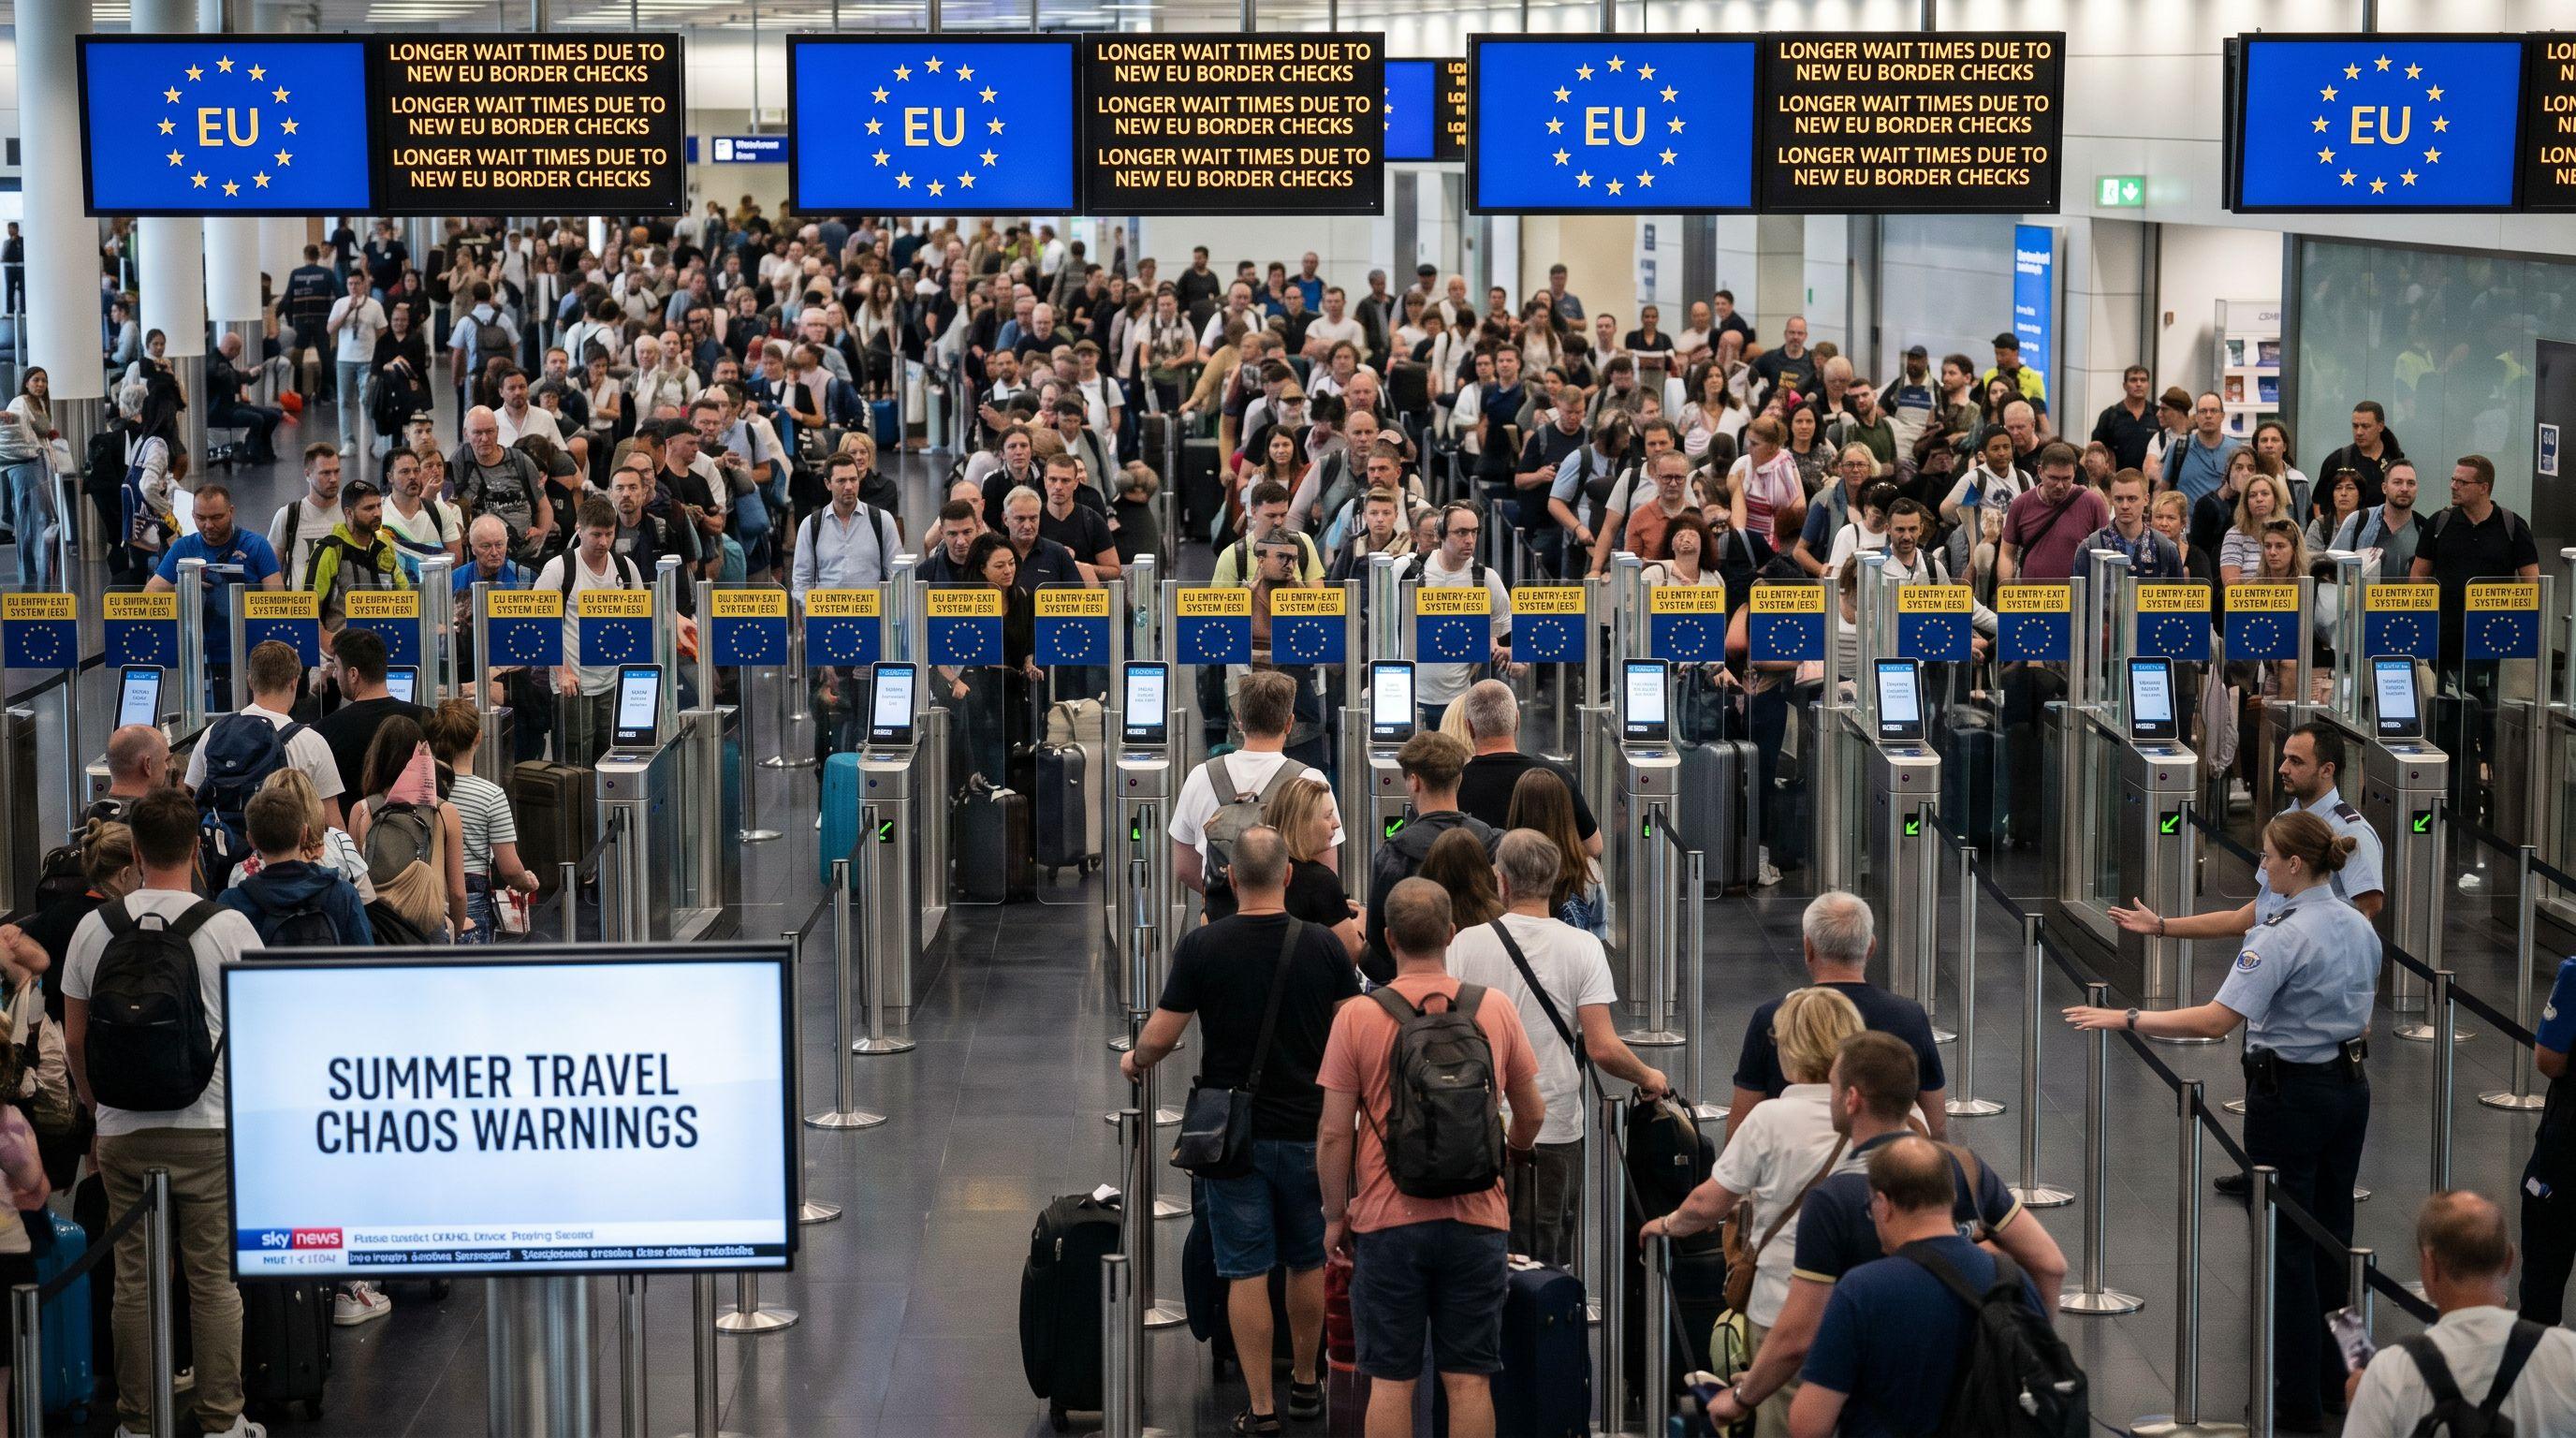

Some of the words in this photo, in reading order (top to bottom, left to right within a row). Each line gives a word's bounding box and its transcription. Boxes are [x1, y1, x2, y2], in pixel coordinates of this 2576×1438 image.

[389, 43, 469, 61] LONGER
[473, 43, 525, 61] WAIT
[528, 43, 588, 61] TIMES
[593, 43, 634, 61] DUE
[637, 43, 666, 61] TO
[1098, 43, 1177, 61] LONGER
[1180, 43, 1233, 61] WAIT
[1236, 43, 1295, 61] TIMES
[1300, 43, 1340, 61] DUE
[1343, 43, 1371, 61] TO
[1780, 41, 1858, 60] LONGER
[1862, 41, 1914, 59] WAIT
[1917, 41, 1975, 60] TIMES
[1981, 41, 2021, 60] DUE
[2024, 41, 2052, 60] TO
[407, 65, 454, 82] NEW
[459, 65, 484, 82] EU
[490, 65, 568, 82] BORDER
[573, 65, 649, 82] CHECKS
[1115, 65, 1161, 82] NEW
[1165, 65, 1191, 82] EU
[1196, 65, 1275, 82] BORDER
[1279, 65, 1354, 82] CHECKS
[1796, 64, 1842, 81] NEW
[1847, 64, 1872, 81] EU
[1878, 63, 1955, 81] BORDER
[1960, 63, 2034, 81] CHECKS
[391, 96, 471, 114] LONGER
[474, 96, 526, 114] WAIT
[530, 95, 589, 114] TIMES
[594, 95, 635, 113] DUE
[638, 95, 666, 113] TO
[1098, 95, 1177, 113] LONGER
[1180, 95, 1233, 113] WAIT
[1236, 95, 1295, 113] TIMES
[1300, 95, 1339, 113] DUE
[1343, 95, 1371, 113] TO
[1779, 95, 1857, 112] LONGER
[1861, 95, 1912, 112] WAIT
[1915, 95, 1973, 112] TIMES
[1979, 95, 2018, 112] DUE
[2023, 95, 2049, 112] TO
[198, 107, 259, 147] EU
[409, 118, 455, 135] NEW
[461, 118, 485, 136] EU
[490, 117, 570, 136] BORDER
[574, 117, 650, 136] CHECKS
[904, 107, 965, 147] EU
[1115, 117, 1161, 135] NEW
[1166, 117, 1191, 135] EU
[1196, 117, 1275, 135] BORDER
[1279, 117, 1354, 135] CHECKS
[1585, 106, 1646, 146] EU
[1794, 116, 1840, 134] NEW
[1845, 116, 1870, 134] EU
[1876, 116, 1954, 134] BORDER
[1958, 116, 2032, 134] CHECKS
[2350, 106, 2411, 145] EU
[393, 148, 472, 166] LONGER
[476, 148, 528, 166] WAIT
[531, 148, 591, 166] TIMES
[596, 148, 637, 166] DUE
[639, 148, 667, 166] TO
[1098, 148, 1177, 166] LONGER
[1180, 148, 1233, 166] WAIT
[1236, 148, 1295, 166] TIMES
[1300, 148, 1339, 166] DUE
[1343, 147, 1371, 165] TO
[1778, 146, 1855, 165] LONGER
[1859, 146, 1910, 164] WAIT
[1914, 146, 1972, 164] TIMES
[1977, 146, 2017, 164] DUE
[2021, 146, 2048, 164] TO
[411, 170, 457, 188] NEW
[461, 170, 487, 188] EU
[492, 169, 572, 188] BORDER
[576, 169, 651, 187] CHECKS
[1115, 169, 1161, 187] NEW
[1166, 169, 1191, 187] EU
[1196, 169, 1275, 187] BORDER
[1279, 169, 1354, 187] CHECKS
[1794, 169, 1840, 186] NEW
[1844, 169, 1869, 186] EU
[1875, 168, 1952, 186] BORDER
[1956, 168, 2030, 186] CHECKS
[1183, 593, 1195, 602] EU
[1276, 593, 1289, 602] EU
[1422, 592, 1434, 601] EU
[1517, 591, 1530, 601] EU
[1755, 590, 1768, 599] EU
[1770, 590, 1821, 599] ENTRY-EXIT
[1904, 590, 1916, 599] EU
[2002, 589, 2014, 599] EU
[2016, 589, 2066, 598] ENTRY-EXIT
[2142, 589, 2154, 598] EU
[2230, 589, 2242, 598] EU
[2371, 588, 2383, 597] EU
[2471, 588, 2483, 597] EU
[2485, 587, 2534, 597] ENTRY-EXIT
[582, 594, 594, 604] EU
[811, 594, 823, 603] EU
[2006, 599, 2041, 609] SYSTEM
[2145, 599, 2181, 609] SYSTEM
[2232, 598, 2268, 609] SYSTEM
[2375, 598, 2410, 608] SYSTEM
[2474, 597, 2509, 608] SYSTEM
[814, 604, 850, 613] SYSTEM
[1186, 603, 1222, 612] SYSTEM
[1280, 603, 1315, 612] SYSTEM
[1425, 602, 1461, 611] SYSTEM
[1518, 601, 1555, 611] SYSTEM
[1759, 600, 1794, 609] SYSTEM
[1907, 600, 1942, 609] SYSTEM
[112, 607, 147, 616] SYSTEM
[253, 606, 288, 615] SYSTEM
[329, 1056, 512, 1100] SUMMER
[526, 1053, 680, 1097] TRAVEL
[316, 1109, 459, 1153] CHAOS
[472, 1106, 699, 1152] WARNINGS
[261, 1231, 290, 1249] sky
[296, 1232, 340, 1245] news
